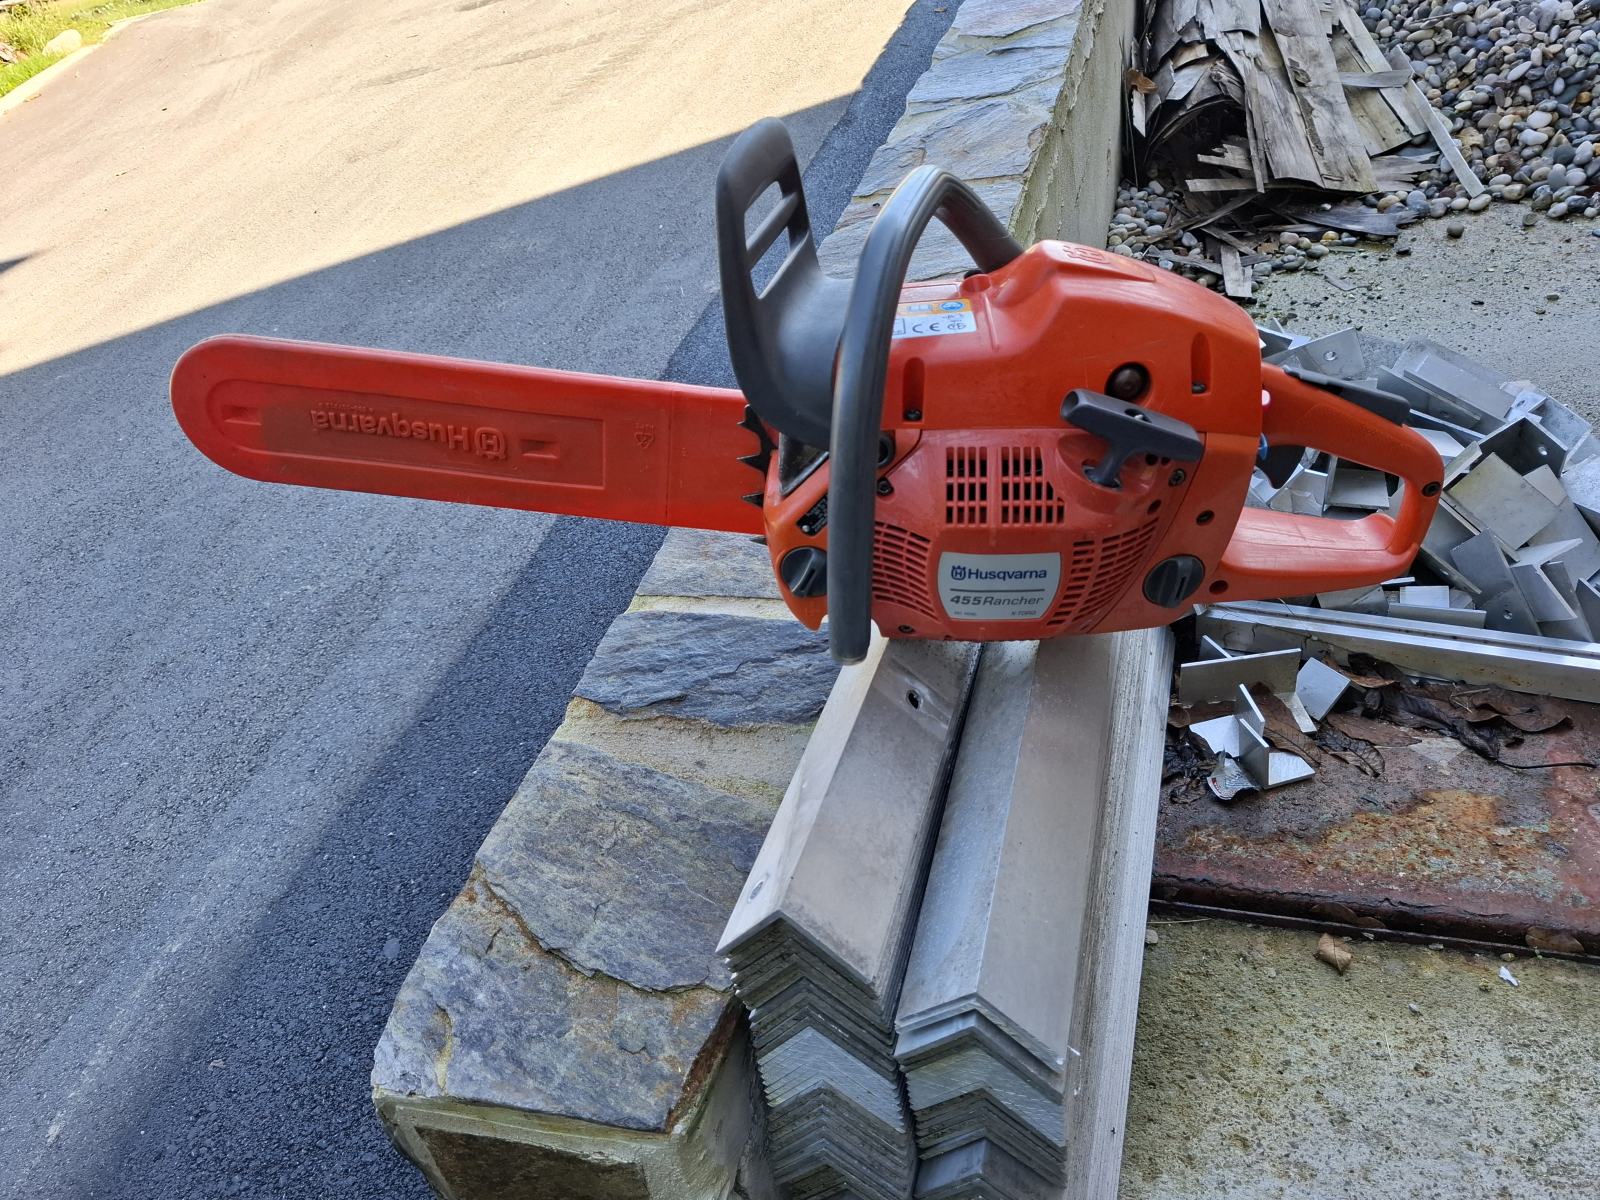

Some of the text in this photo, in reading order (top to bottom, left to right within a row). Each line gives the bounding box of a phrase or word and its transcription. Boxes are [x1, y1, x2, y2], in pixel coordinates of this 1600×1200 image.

[310, 409, 470, 451] Husqvarna
[967, 568, 1047, 581] Husqvarna
[950, 595, 1044, 606] 455 Rancher
